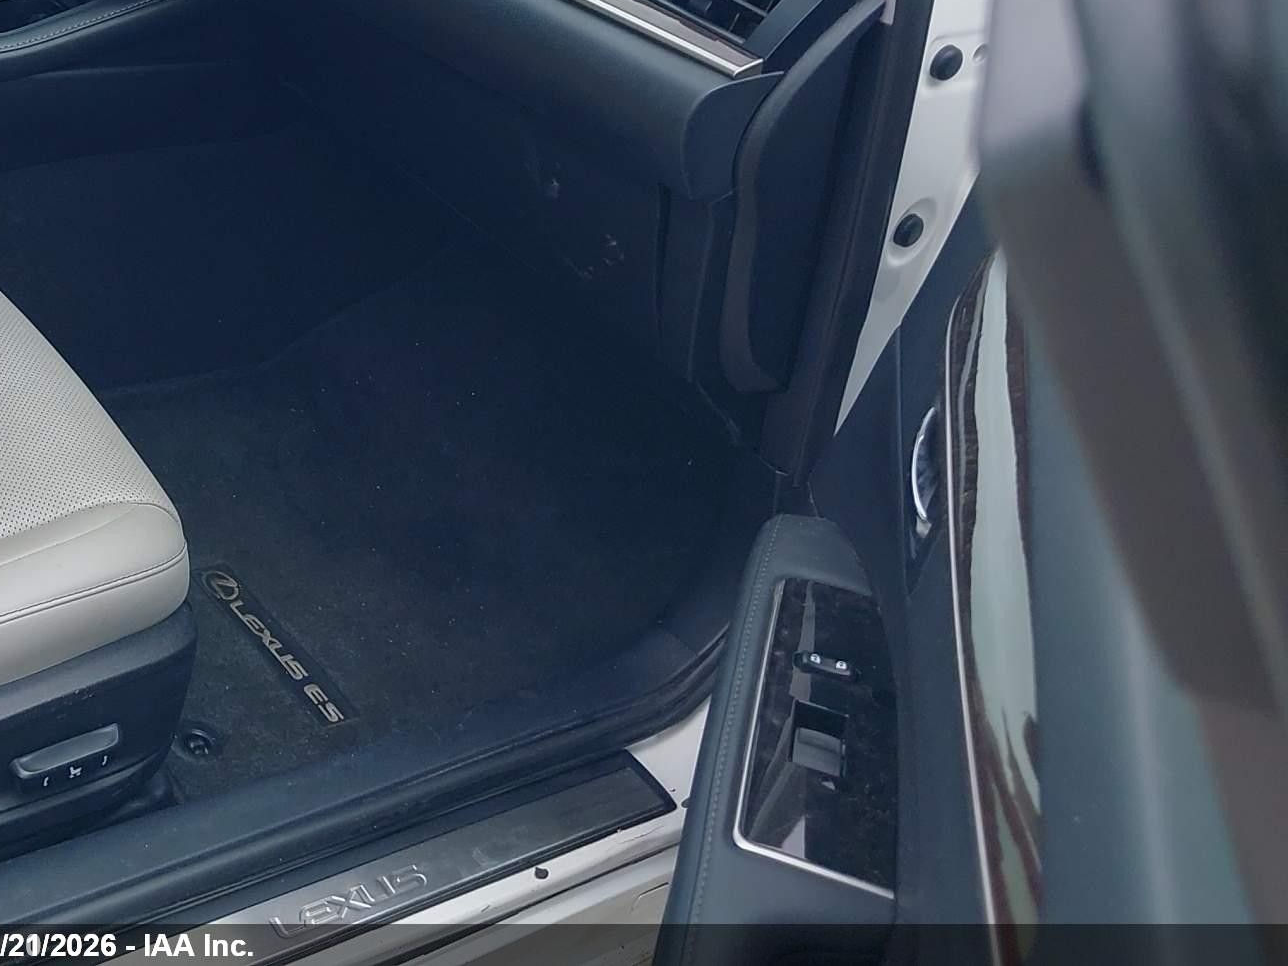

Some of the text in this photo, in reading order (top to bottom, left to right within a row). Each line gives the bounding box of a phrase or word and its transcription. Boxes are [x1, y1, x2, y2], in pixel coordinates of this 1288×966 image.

[230, 599, 345, 723] LEXUS ES
[268, 864, 428, 939] LEXUS
